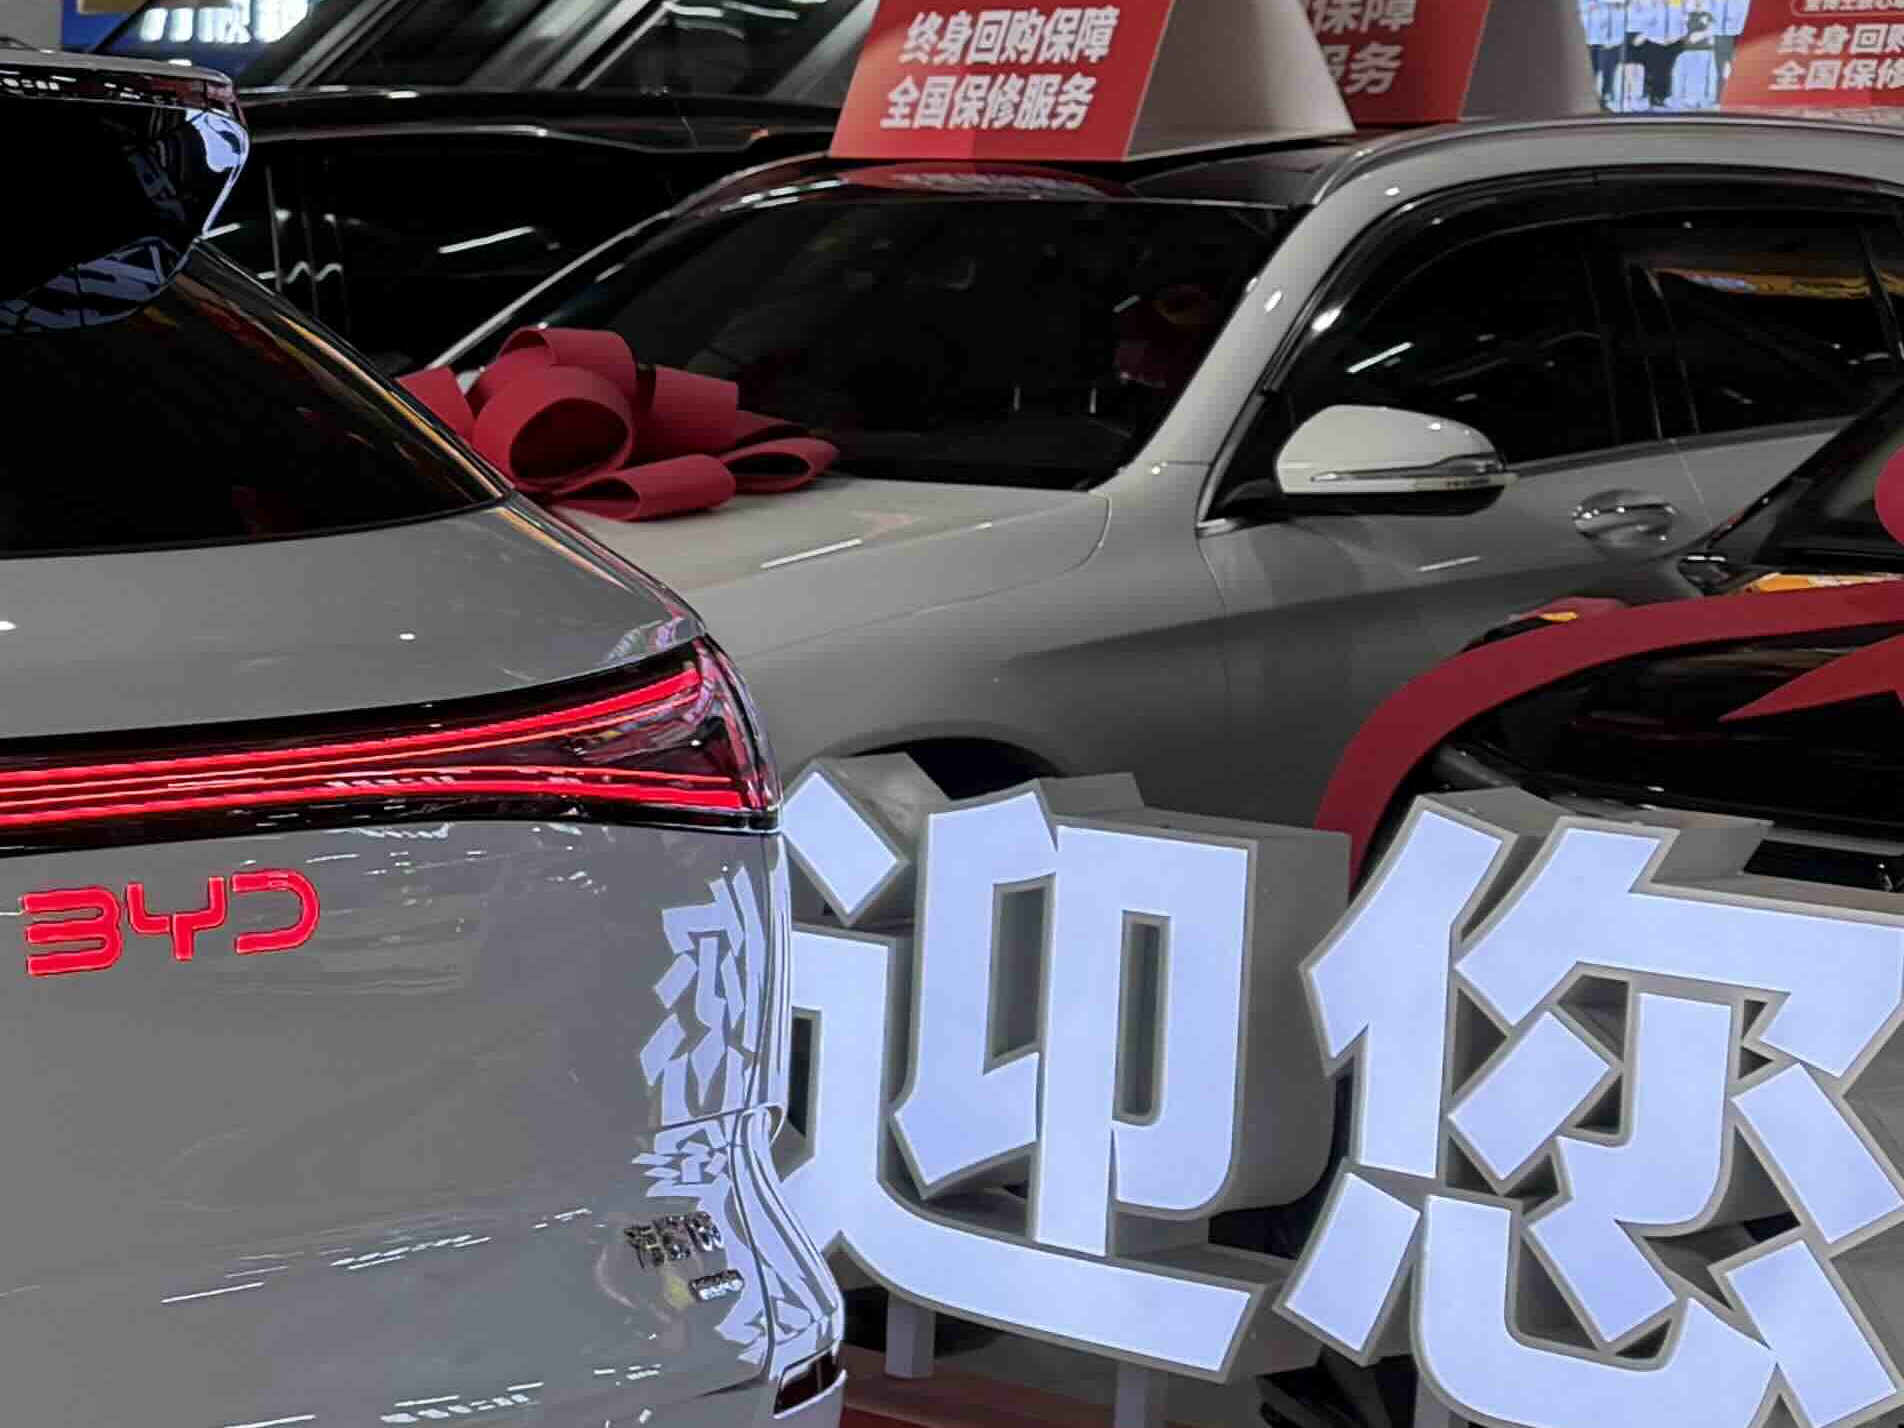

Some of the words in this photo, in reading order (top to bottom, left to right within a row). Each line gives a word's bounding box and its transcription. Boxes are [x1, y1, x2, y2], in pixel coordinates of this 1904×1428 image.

[898, 5, 1121, 66] 终身回购保障
[879, 72, 1097, 131] 全国保修服务
[20, 867, 321, 979] BYD
